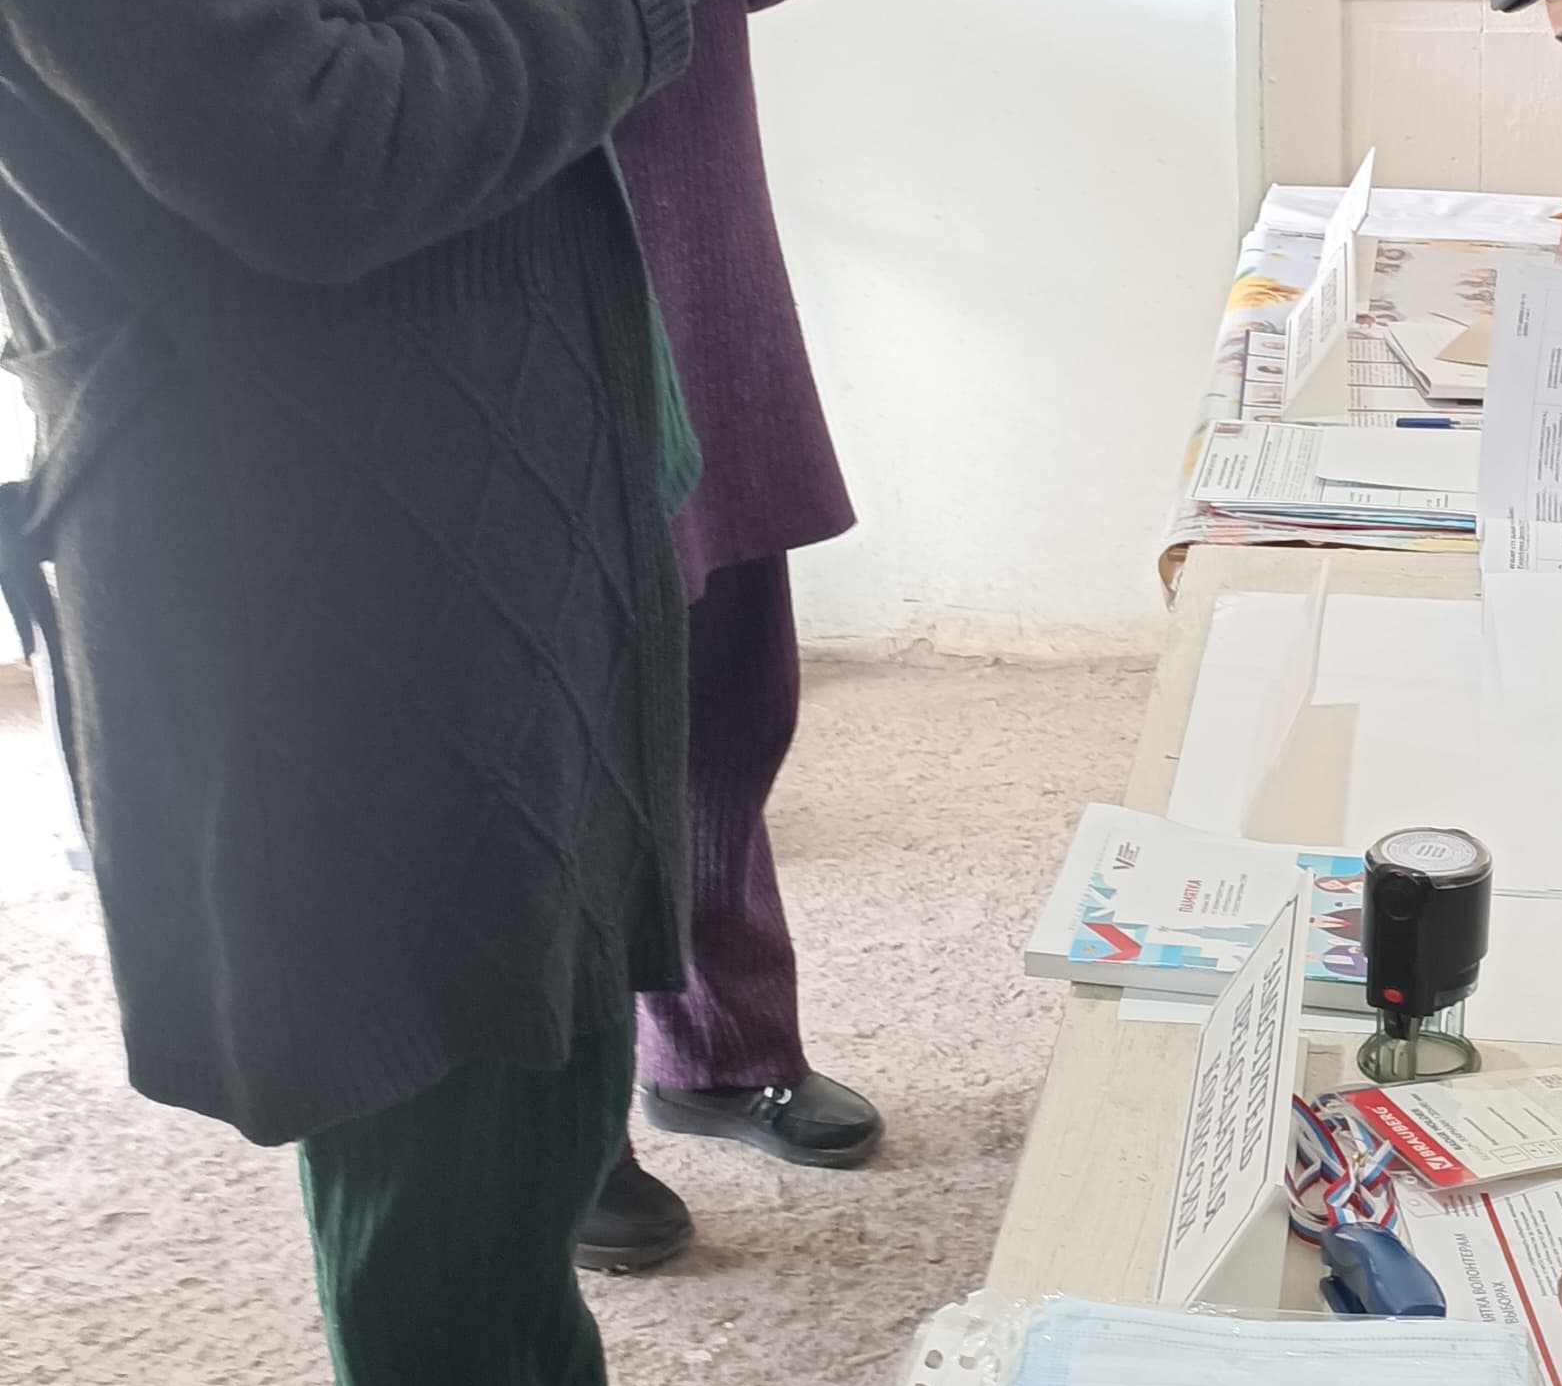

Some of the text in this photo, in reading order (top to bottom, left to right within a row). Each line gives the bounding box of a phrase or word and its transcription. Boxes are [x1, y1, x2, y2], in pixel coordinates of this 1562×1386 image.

[1178, 879, 1202, 913] ПАМЯТКА
[1239, 947, 1285, 1173] ЗАМЕСТИТЕЛЬ
[1202, 983, 1255, 1234] ПРЕДСЕДАТЕЛЯ
[1371, 1105, 1438, 1158] BRAUBERG
[1411, 1108, 1442, 1132] HOLDER
[1173, 1050, 1222, 1251] КОМИССИИ
[1454, 1232, 1487, 1295] ВОЛОНТЕРАМ
[1491, 1280, 1519, 1324] ВЫБОРАХ
